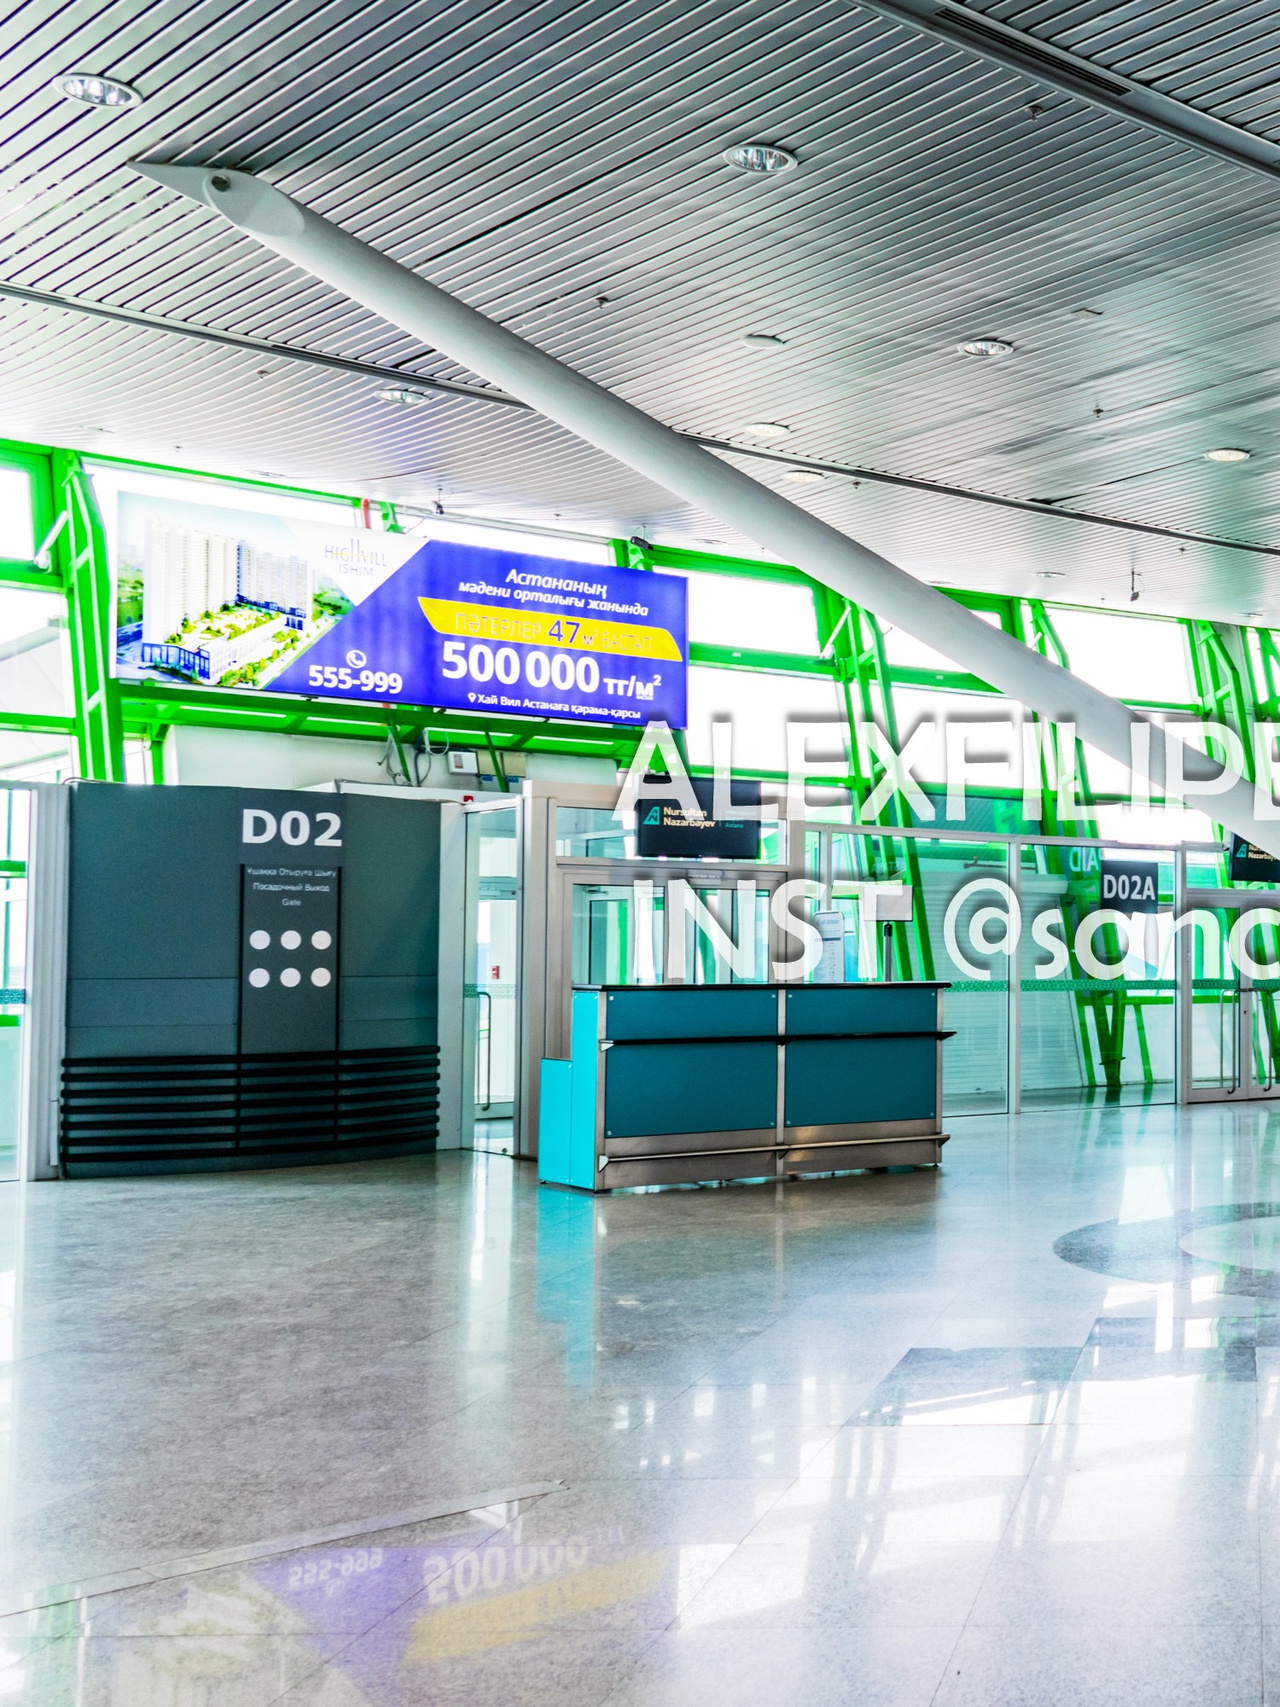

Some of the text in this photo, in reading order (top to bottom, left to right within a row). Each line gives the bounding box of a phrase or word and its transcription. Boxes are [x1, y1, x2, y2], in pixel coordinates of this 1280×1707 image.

[339, 564, 374, 576] ISHIM
[505, 568, 608, 599] Астананың
[458, 580, 649, 616] мәдени орталығы жанында
[455, 613, 541, 639] ПӘТЕРЛЕР
[548, 620, 580, 644] 47
[308, 664, 403, 694] 555-999
[442, 640, 520, 685] 500
[525, 651, 600, 693] 000
[477, 694, 498, 705] Хай
[500, 696, 521, 707] Вил
[523, 698, 570, 712] Астанаға
[242, 808, 342, 847] D02
[663, 817, 716, 829] Nazarbayev
[282, 898, 302, 906] Gate
[1103, 874, 1156, 900] D02A
